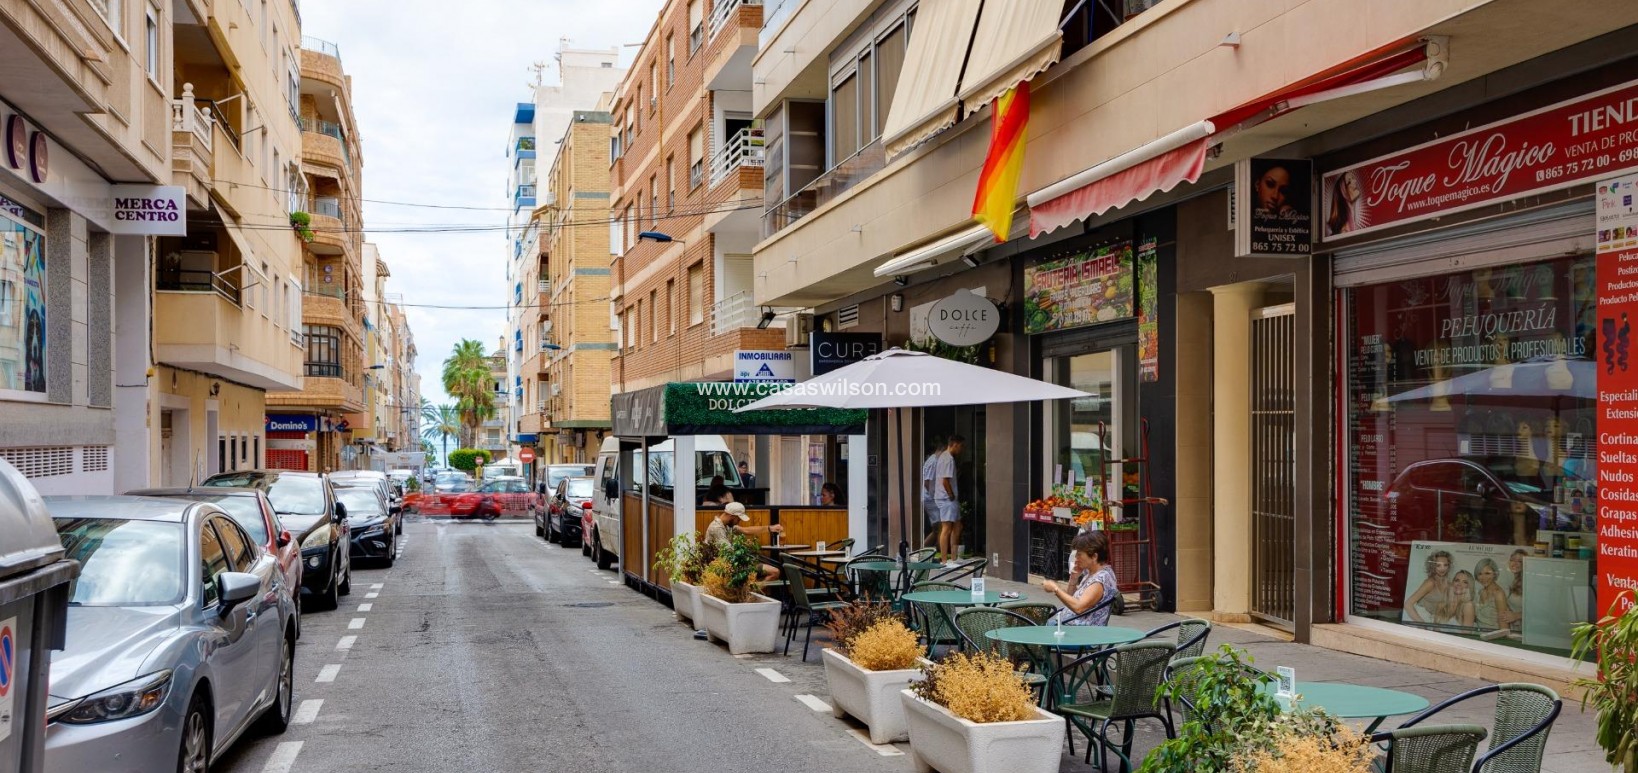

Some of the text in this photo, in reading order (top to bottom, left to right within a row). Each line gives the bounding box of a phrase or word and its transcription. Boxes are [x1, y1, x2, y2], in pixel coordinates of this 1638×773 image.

[1564, 141, 1598, 158] VENTA
[1601, 135, 1616, 149] DE
[1366, 133, 1556, 213] Toque Mágico
[1545, 165, 1563, 179] 865
[1566, 162, 1578, 175] 75
[1581, 158, 1594, 170] 72
[1596, 154, 1610, 167] 00
[1407, 182, 1490, 211] www.toquemagico.es
[115, 198, 178, 210] MERCA
[115, 210, 179, 221] CENTRO
[1268, 233, 1296, 242] UNISEX
[1252, 242, 1310, 252] 865 75 72 00
[1081, 253, 1120, 282] ISMAEL
[1599, 294, 1628, 305] Producto
[940, 309, 987, 321] DOLCE
[1440, 302, 1557, 340] PELUQUERÍA
[738, 352, 792, 360] INMOBILIARIA
[1414, 336, 1586, 366] VENTA DE PRODUCTOS A PROFESIONALES
[270, 421, 308, 430] Domino's
[1600, 450, 1638, 464] Sueltas
[1600, 469, 1634, 482] Nudos
[1600, 506, 1638, 523] Grapas
[1600, 543, 1638, 558] Keratin
[1621, 596, 1638, 609] Pe
